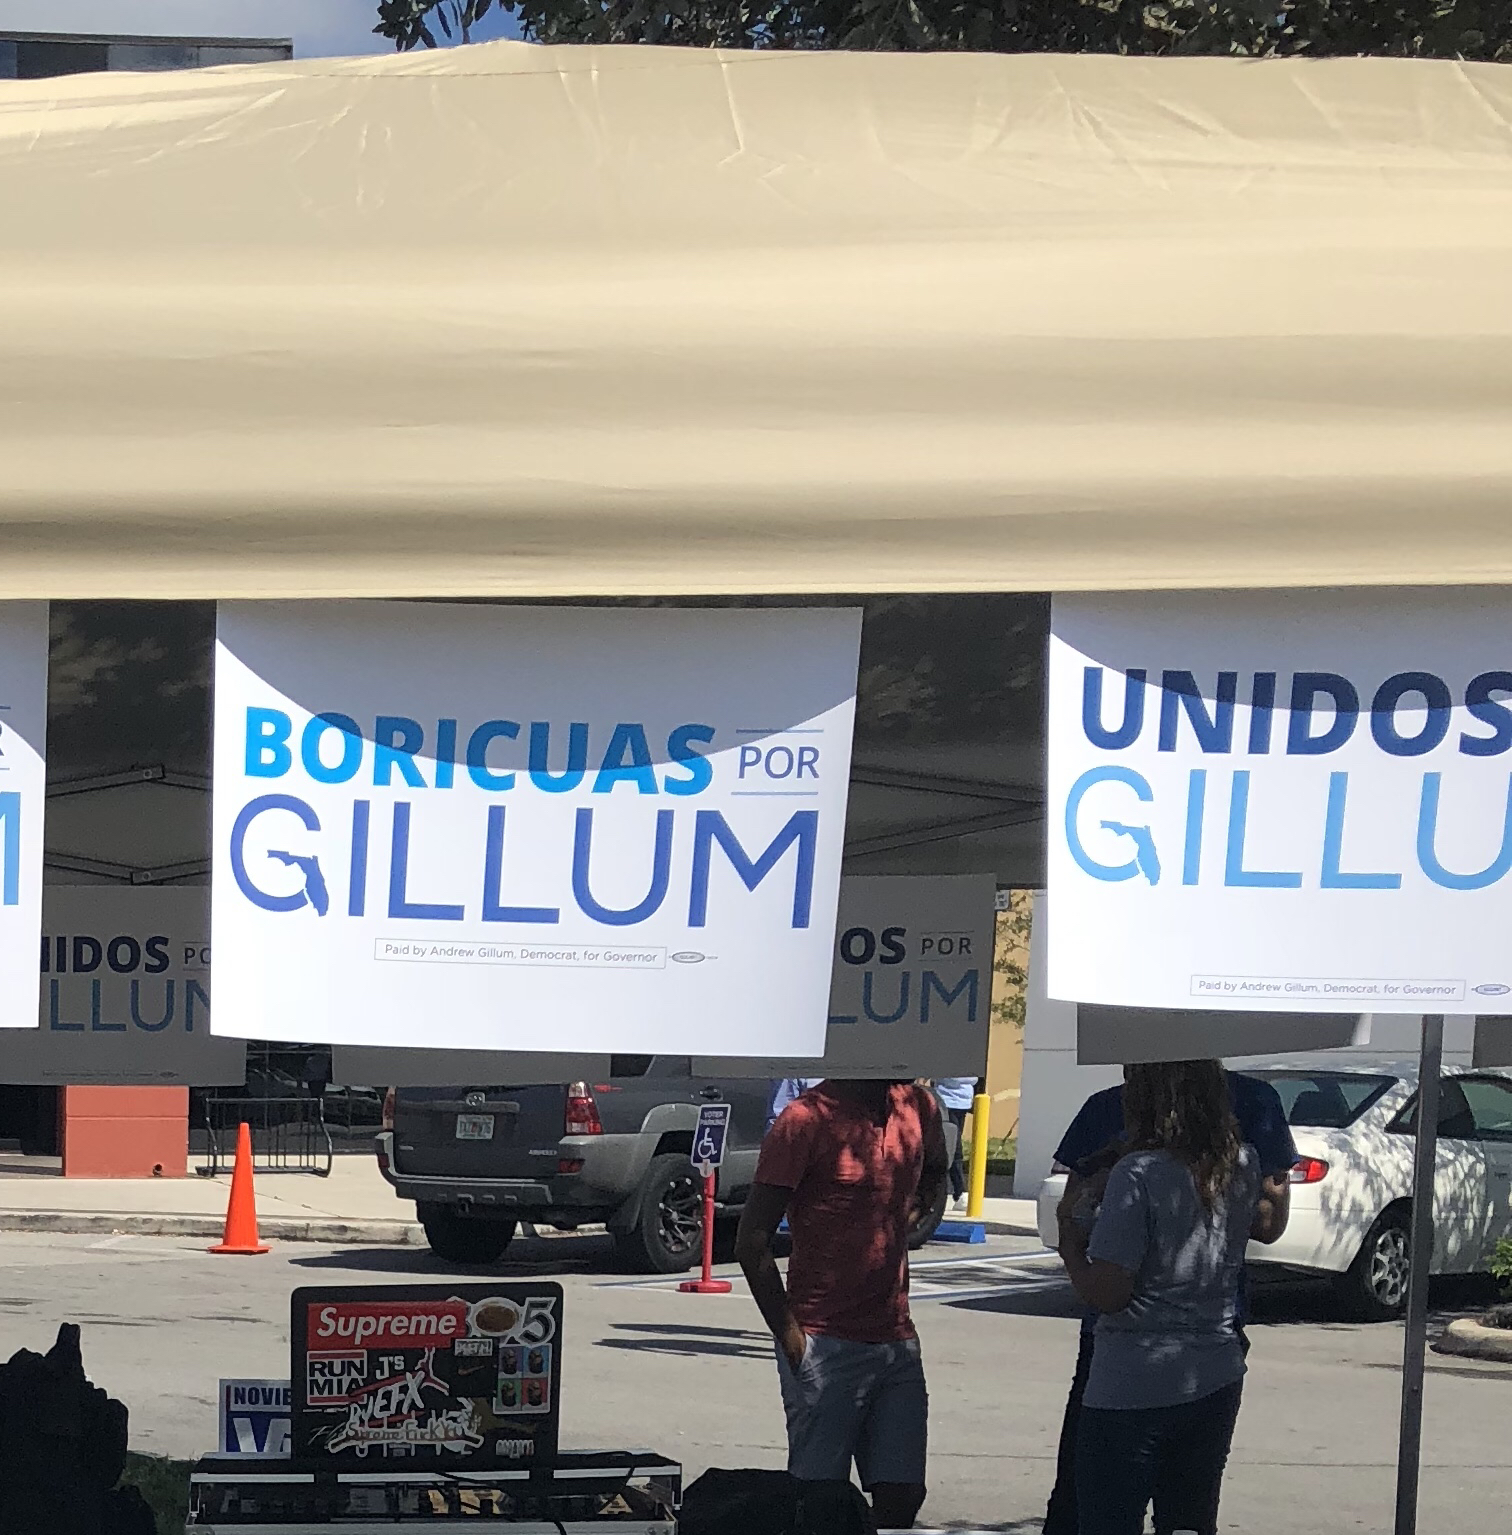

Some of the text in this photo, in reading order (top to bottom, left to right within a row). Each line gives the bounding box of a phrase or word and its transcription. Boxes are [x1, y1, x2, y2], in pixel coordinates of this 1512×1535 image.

[1081, 666, 1512, 758] UNIDOS
[244, 706, 819, 797] BORICUAS POR
[229, 793, 819, 930] GILLUM
[385, 944, 657, 963] Paid by Andrew Gillum, Democrat, for Governor
[921, 937, 972, 955] POR
[1199, 981, 1456, 995] Paid by Andrew Gillum, Democrat, for Governor
[317, 1307, 457, 1344] Supreme
[309, 1360, 364, 1378] RUN
[309, 1378, 364, 1396] MIA
